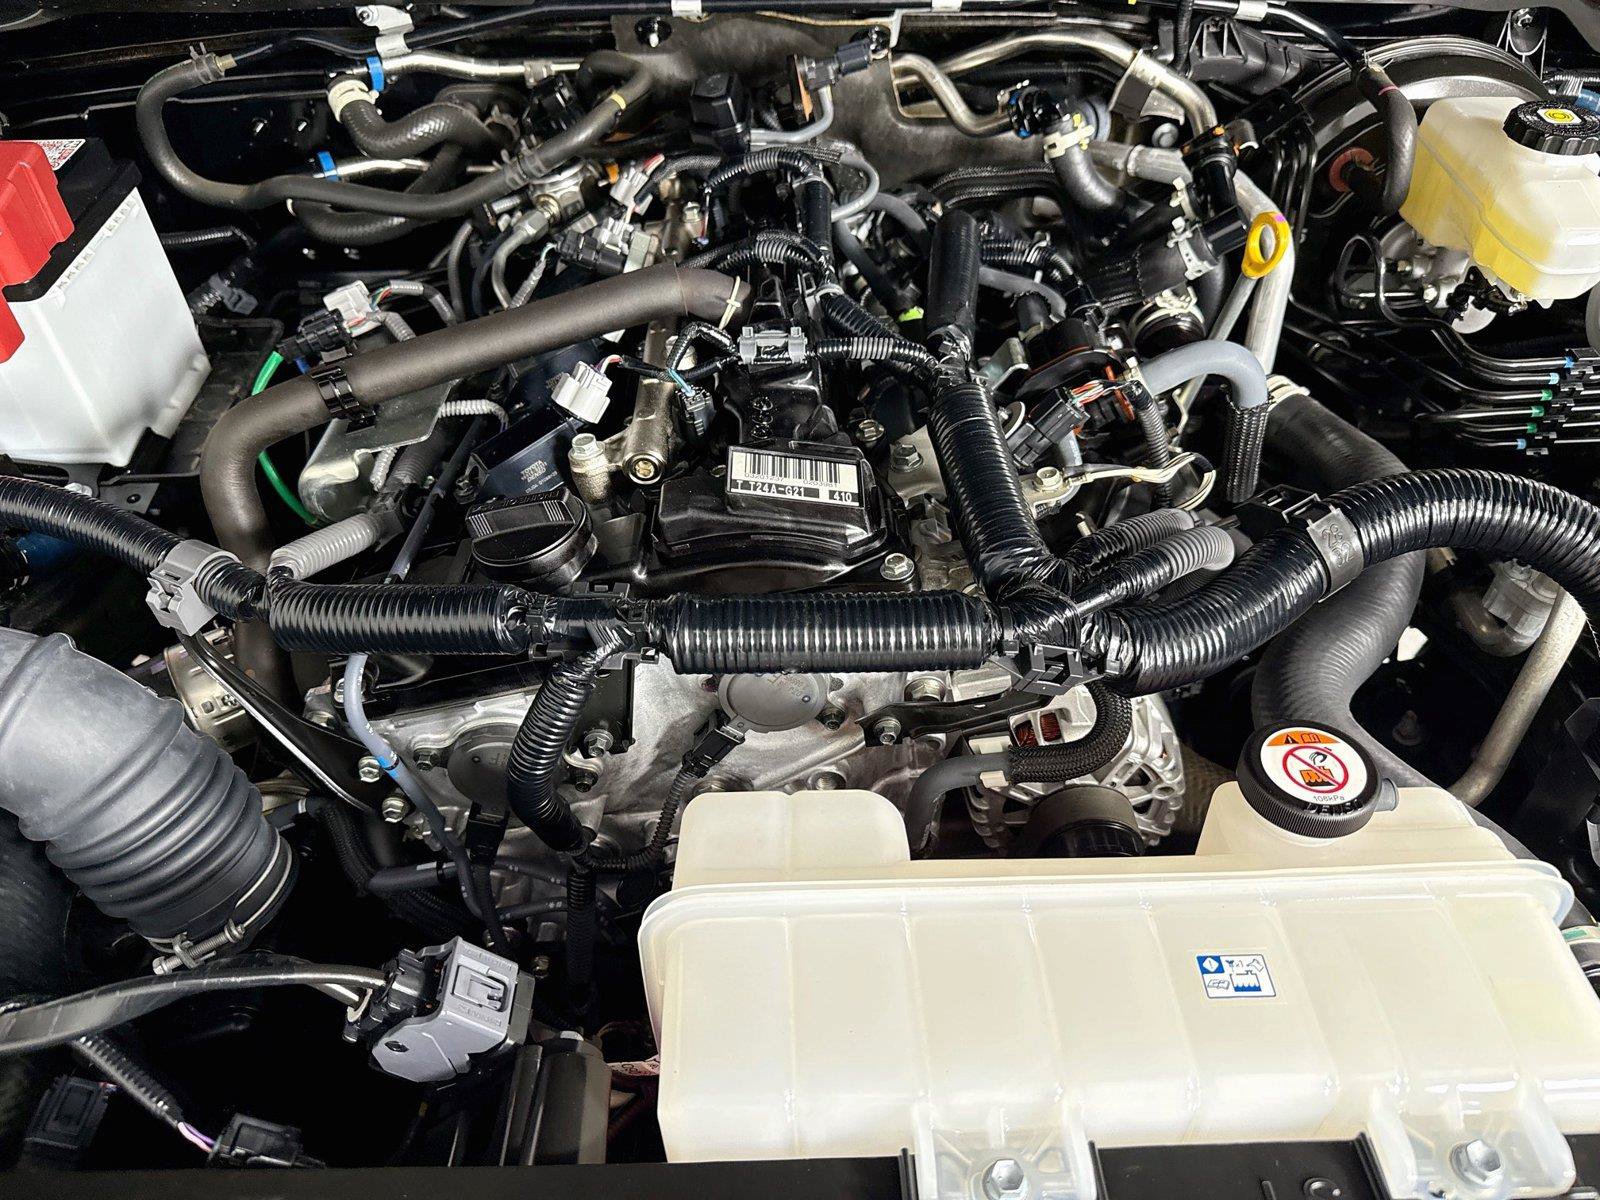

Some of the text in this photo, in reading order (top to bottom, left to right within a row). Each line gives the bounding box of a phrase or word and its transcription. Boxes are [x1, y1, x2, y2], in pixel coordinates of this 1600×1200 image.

[520, 460, 545, 477] TOYOTA
[736, 480, 853, 503] T T24A-G21 410
